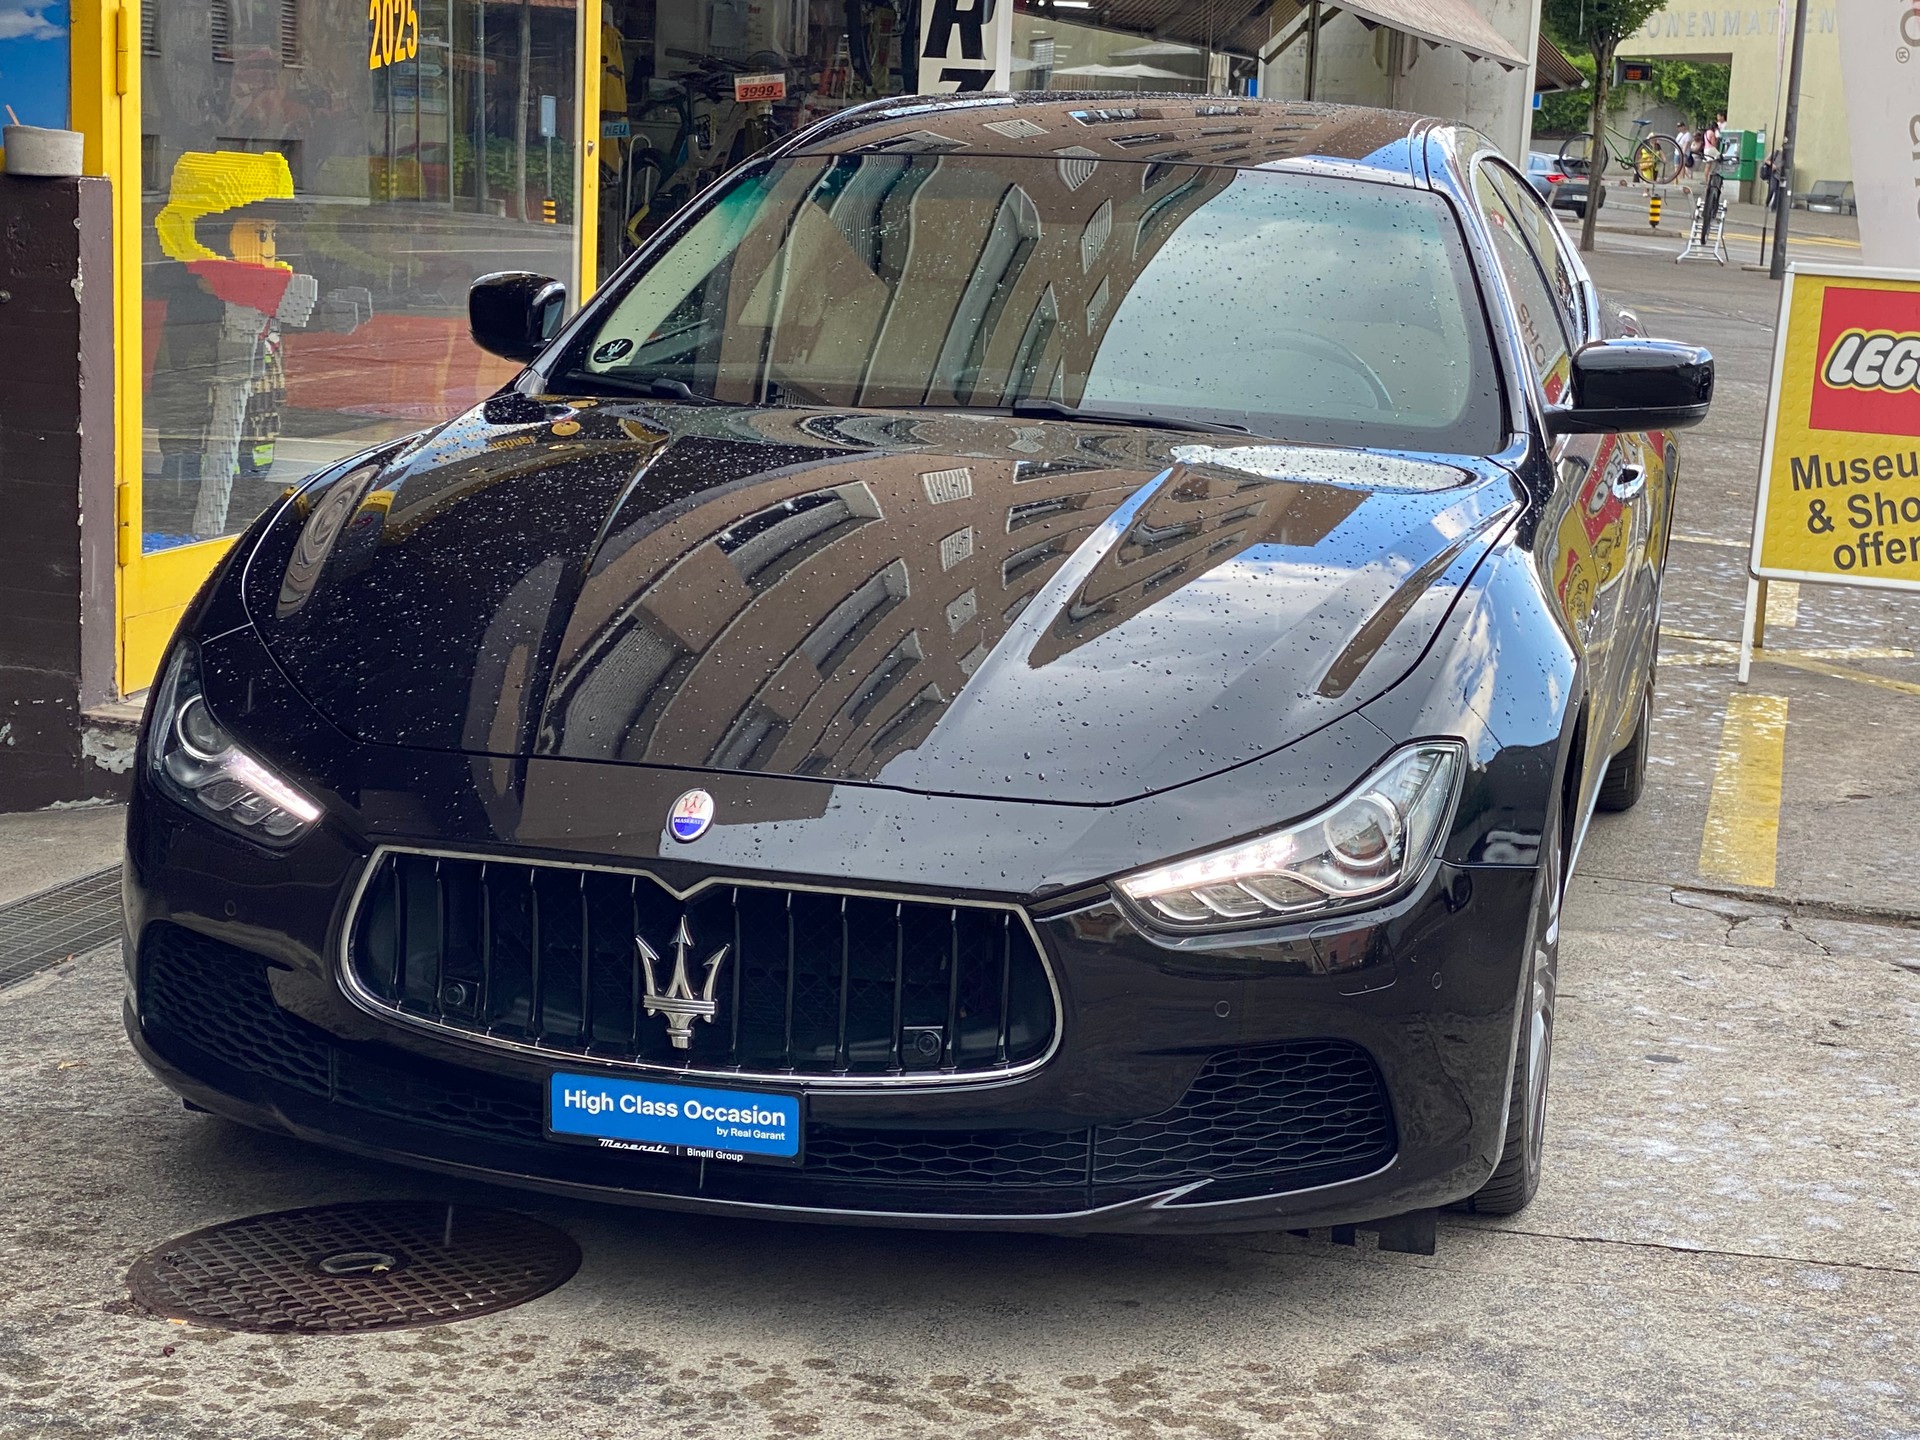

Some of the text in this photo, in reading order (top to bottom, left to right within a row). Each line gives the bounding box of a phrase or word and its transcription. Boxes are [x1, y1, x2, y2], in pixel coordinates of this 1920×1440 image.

[369, 0, 418, 70] 2025
[740, 85, 783, 98] 3999.-
[604, 123, 627, 136] NEU
[1827, 334, 1920, 388] LEG
[1807, 491, 1920, 535] & Sho
[564, 1089, 786, 1127] High Class Occasion
[716, 1126, 786, 1141] by Real Garant
[598, 1138, 744, 1163] Maserati Binelli Group
